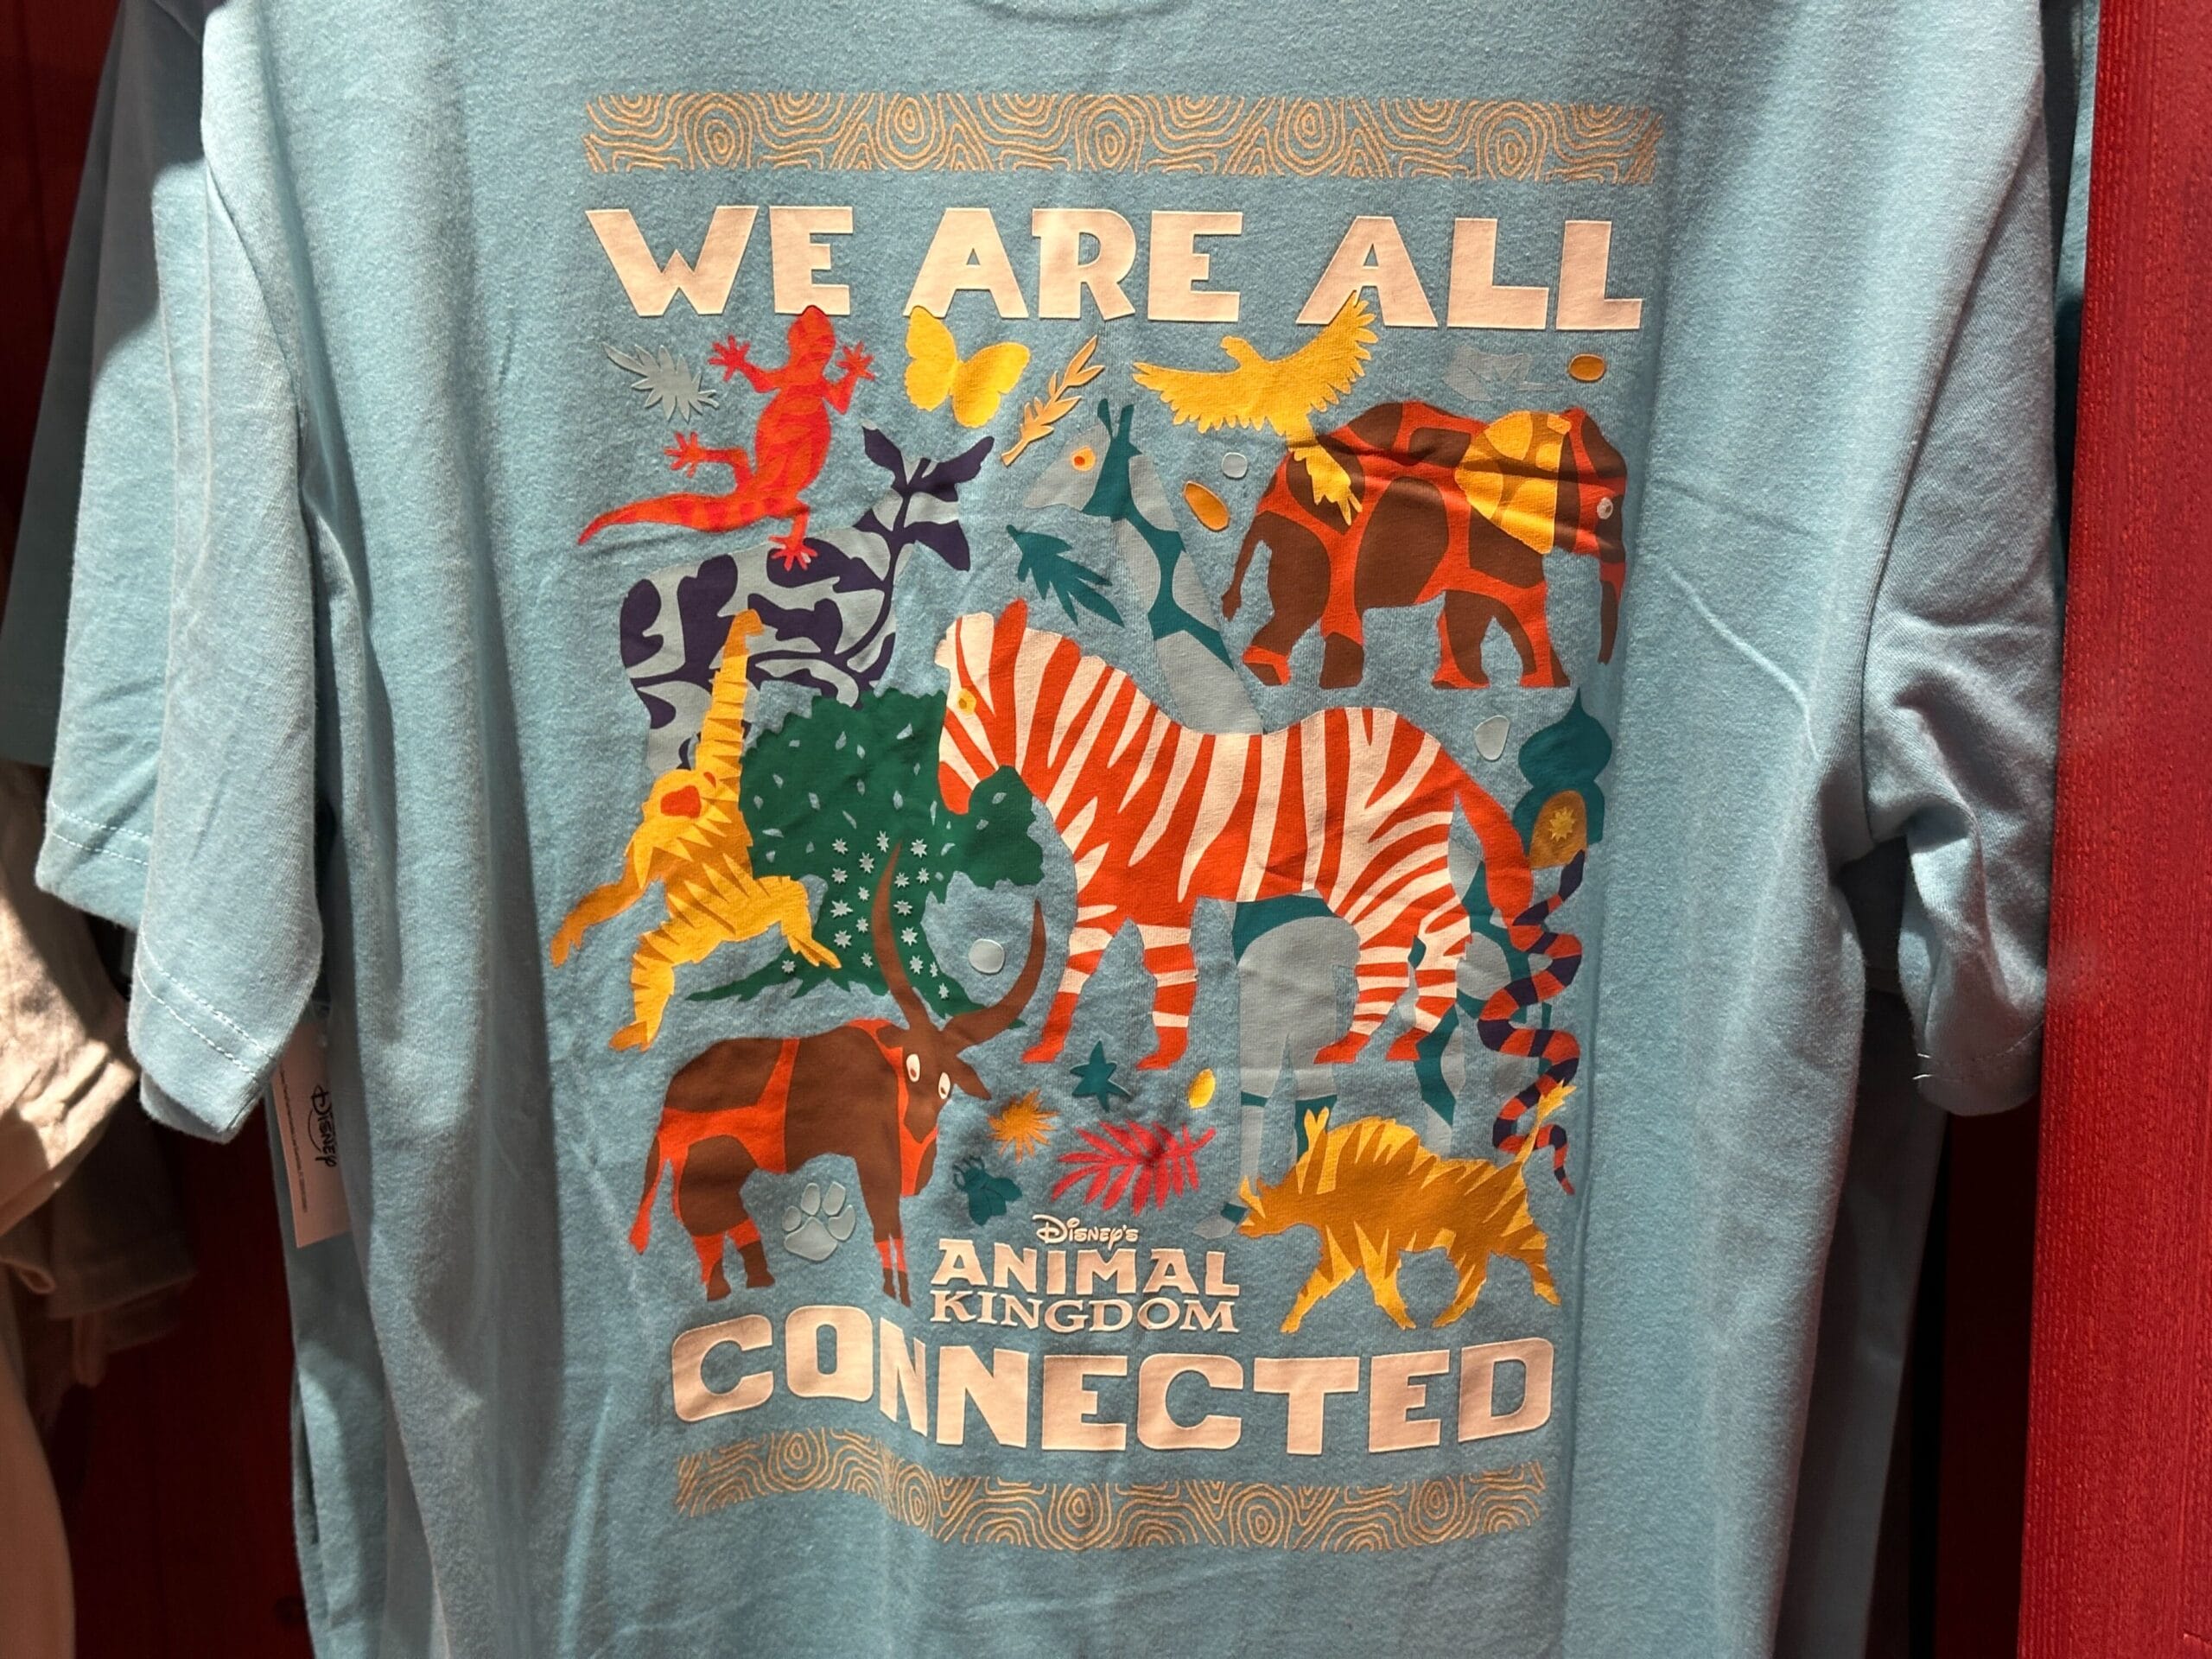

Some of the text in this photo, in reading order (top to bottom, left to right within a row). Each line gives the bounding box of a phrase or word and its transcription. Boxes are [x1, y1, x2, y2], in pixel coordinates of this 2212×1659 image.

[585, 205, 1643, 331] WE ARE ALL
[308, 1084, 338, 1167] Disney
[930, 1237, 1241, 1296] ANIMAL
[929, 1289, 1240, 1333] KINGDOM
[671, 1304, 1554, 1457] CONNECTED
